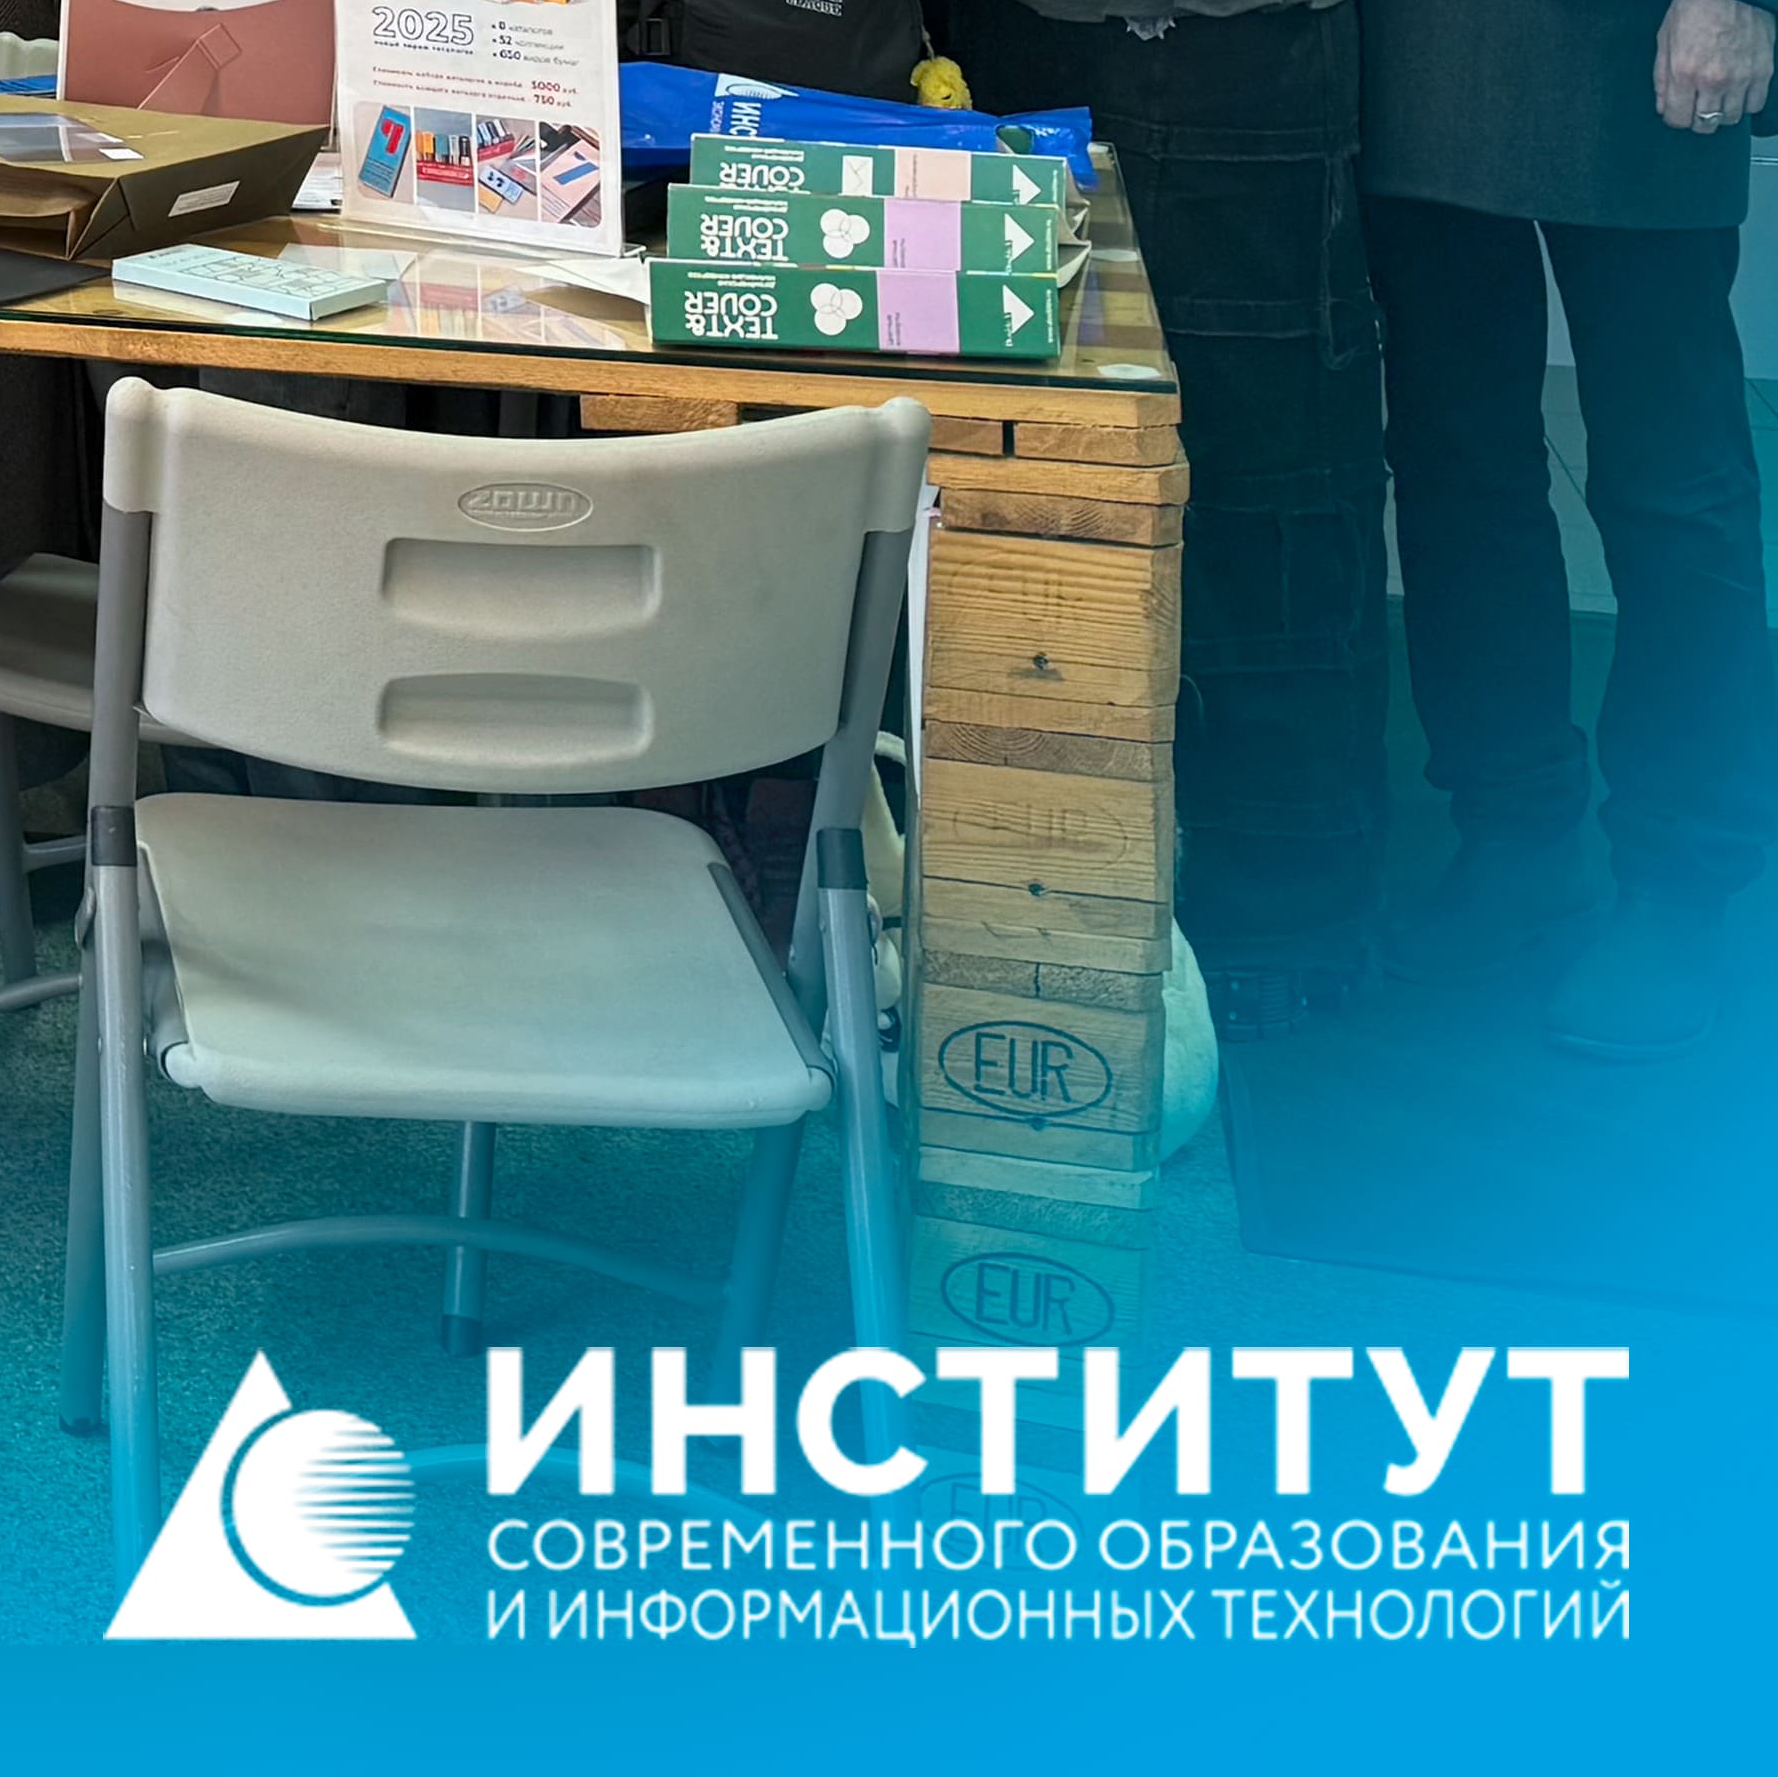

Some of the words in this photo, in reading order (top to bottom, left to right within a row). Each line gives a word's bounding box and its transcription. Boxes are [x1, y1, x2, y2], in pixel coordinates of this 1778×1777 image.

[372, 6, 474, 47] 2025
[700, 213, 789, 237] COVER
[684, 291, 778, 316] COVER
[685, 315, 779, 341] TEXT&
[973, 1031, 1075, 1104] EUR
[974, 1261, 1076, 1336] EUR
